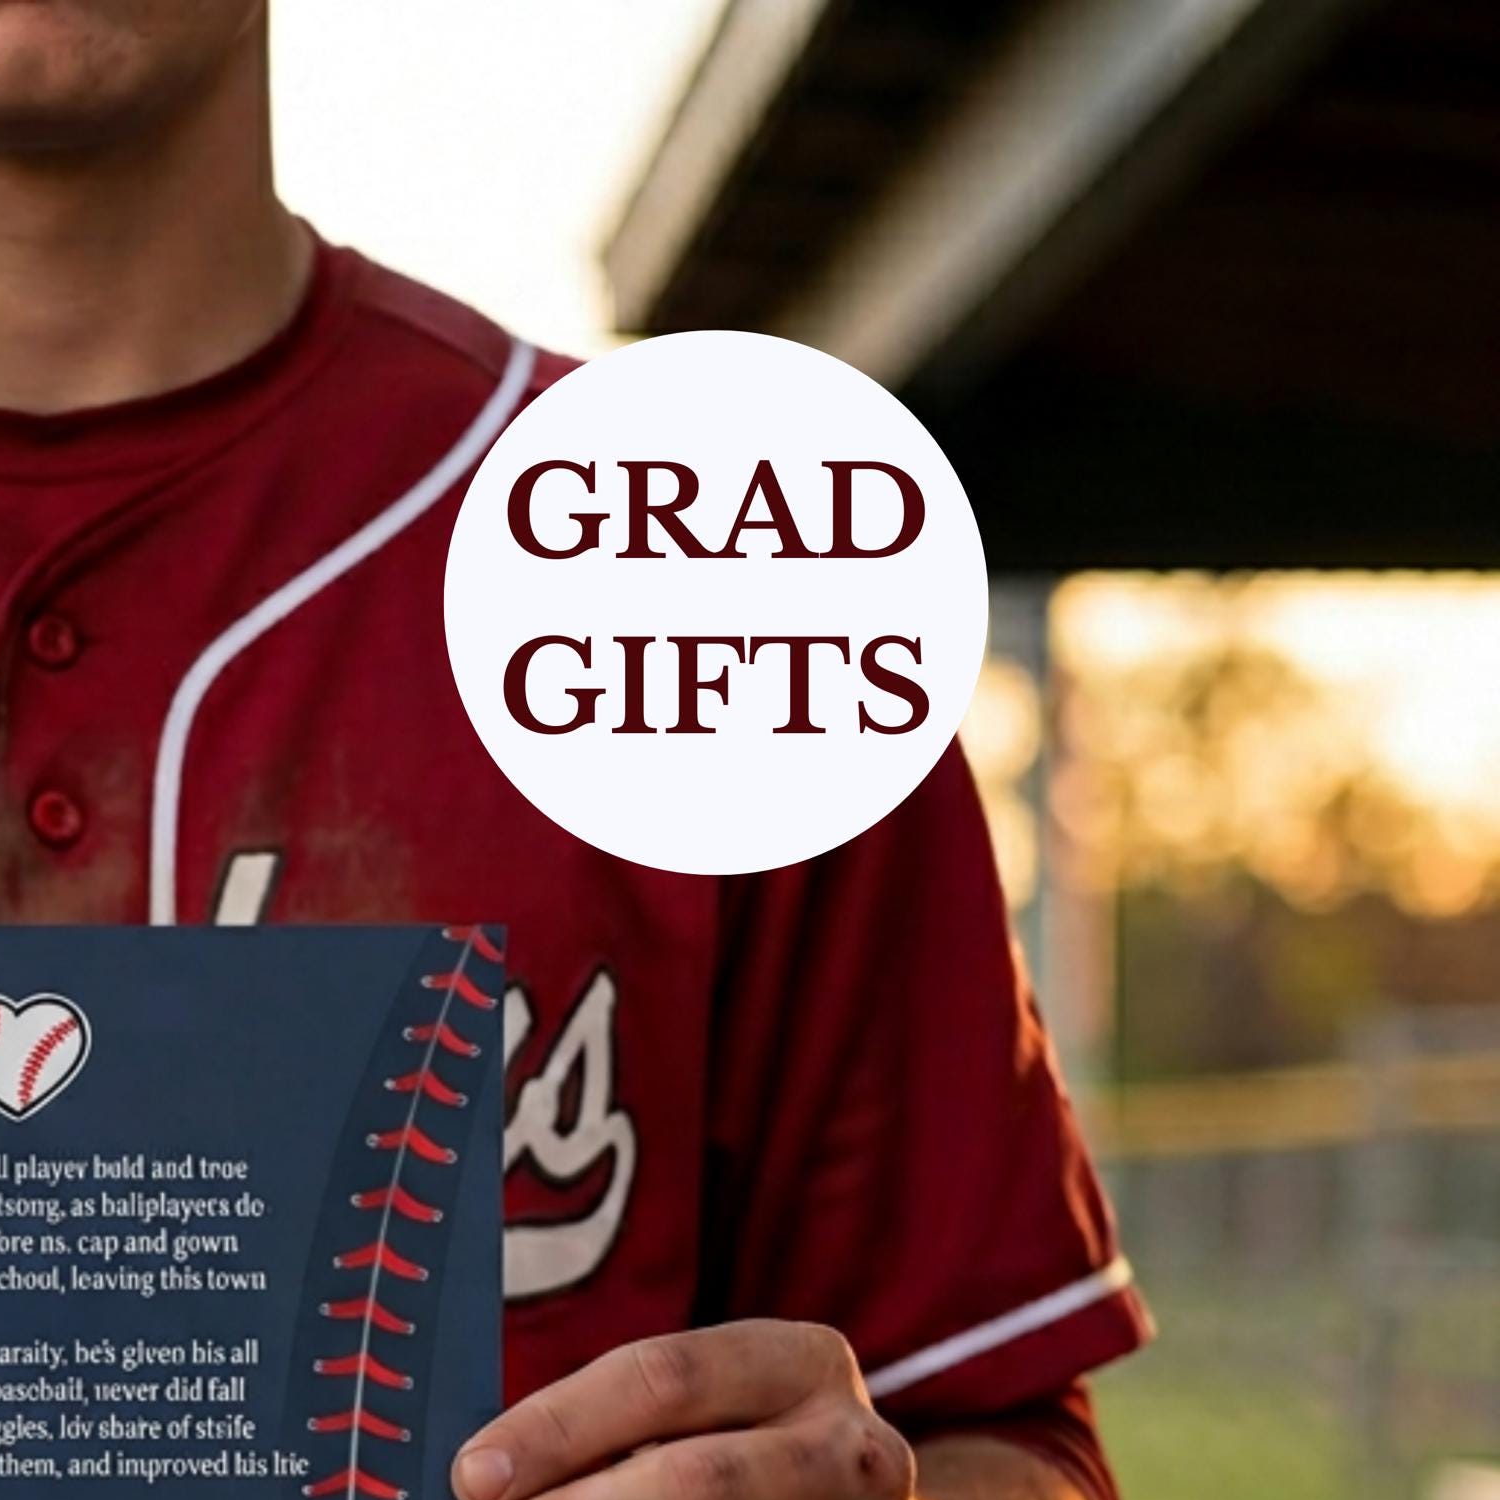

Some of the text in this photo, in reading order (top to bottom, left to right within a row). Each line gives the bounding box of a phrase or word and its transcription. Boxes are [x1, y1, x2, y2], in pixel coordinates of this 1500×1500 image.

[70, 1198, 96, 1217] as
[77, 1235, 119, 1262] cap
[123, 1227, 168, 1254] and
[172, 1235, 239, 1263] gown
[160, 1265, 203, 1291] this
[207, 1269, 267, 1290] town
[230, 1338, 259, 1364] all
[164, 1376, 203, 1402] did
[207, 1376, 245, 1402] fall
[166, 1413, 192, 1440] of
[67, 1450, 111, 1477] and
